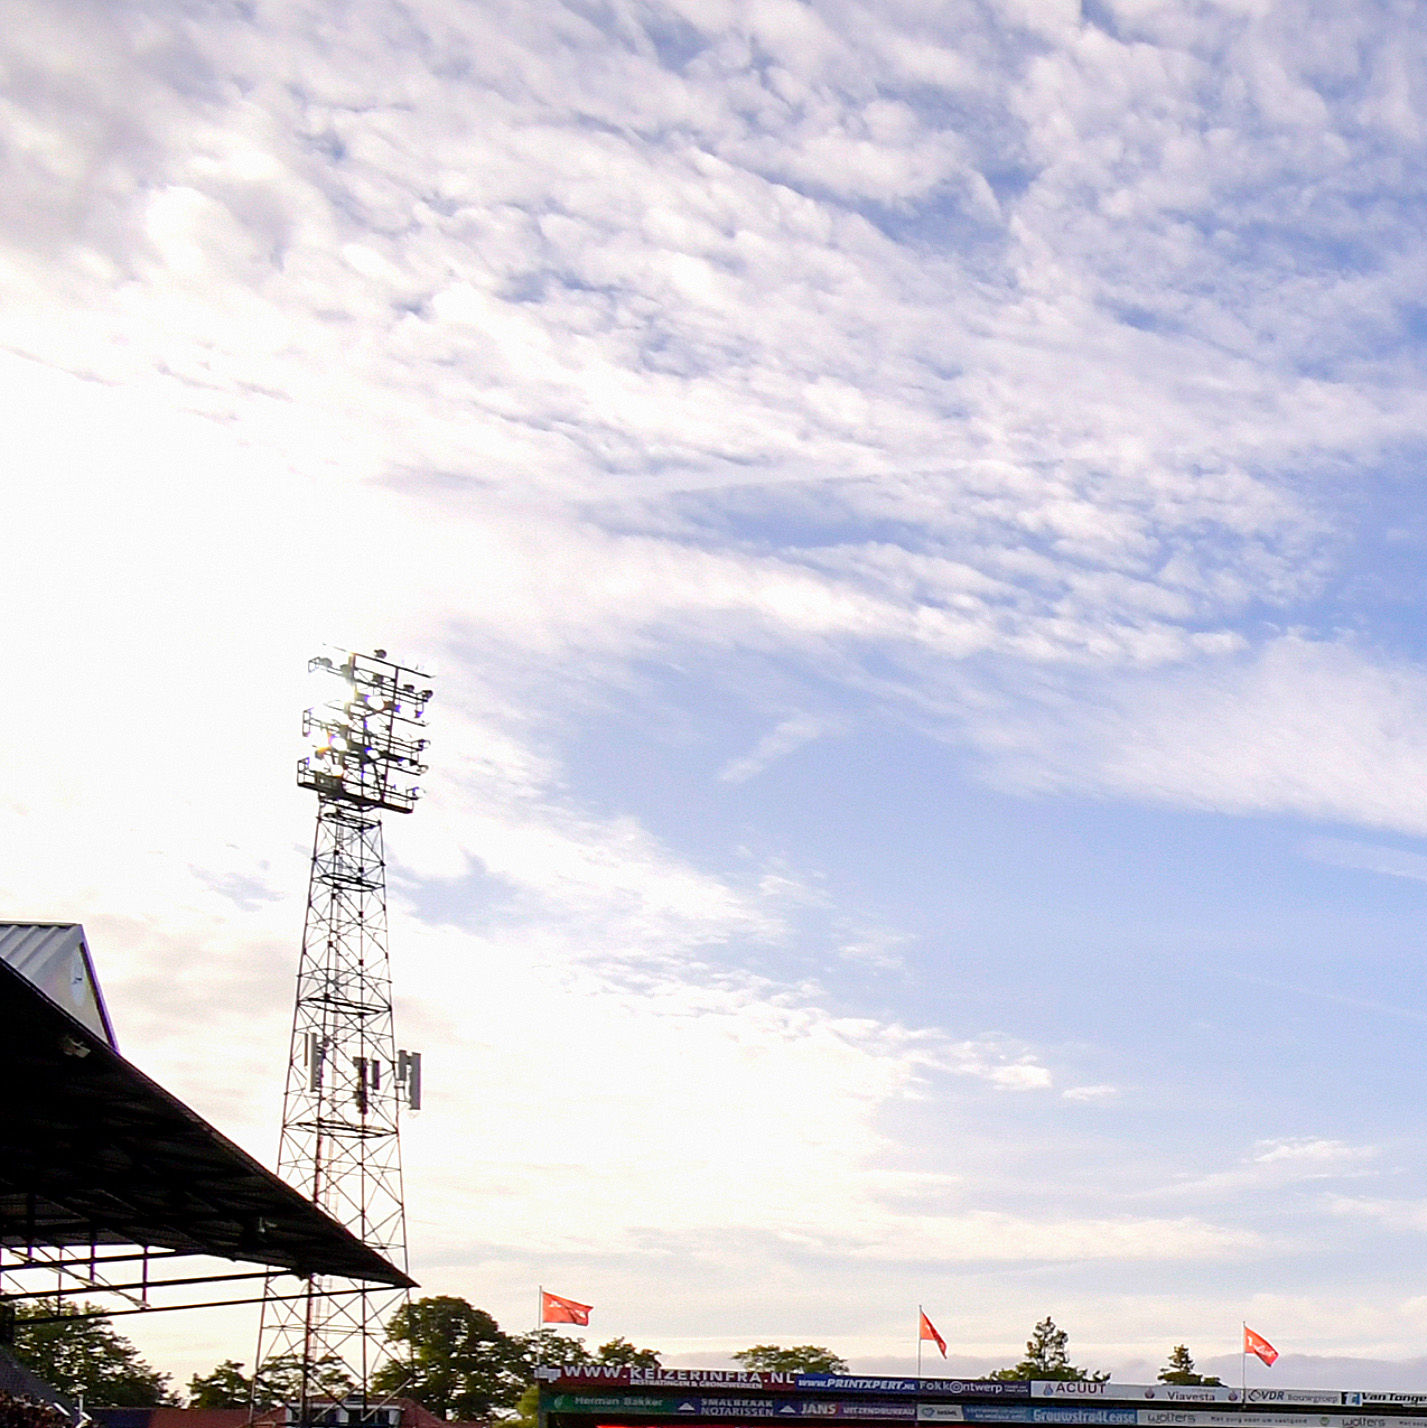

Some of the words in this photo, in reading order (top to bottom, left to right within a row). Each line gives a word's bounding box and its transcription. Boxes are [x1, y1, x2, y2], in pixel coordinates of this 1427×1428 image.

[565, 1365, 795, 1384] WWW.KEIZERINFRA.NL
[1056, 1382, 1106, 1394] ACUUT
[1167, 1391, 1215, 1401] Viavesta
[1262, 1391, 1284, 1400] VDR
[1362, 1392, 1386, 1401] Van
[701, 1398, 773, 1407] SMALBRAAK
[701, 1407, 774, 1417] NOTARISSEN
[801, 1403, 837, 1415] JANS
